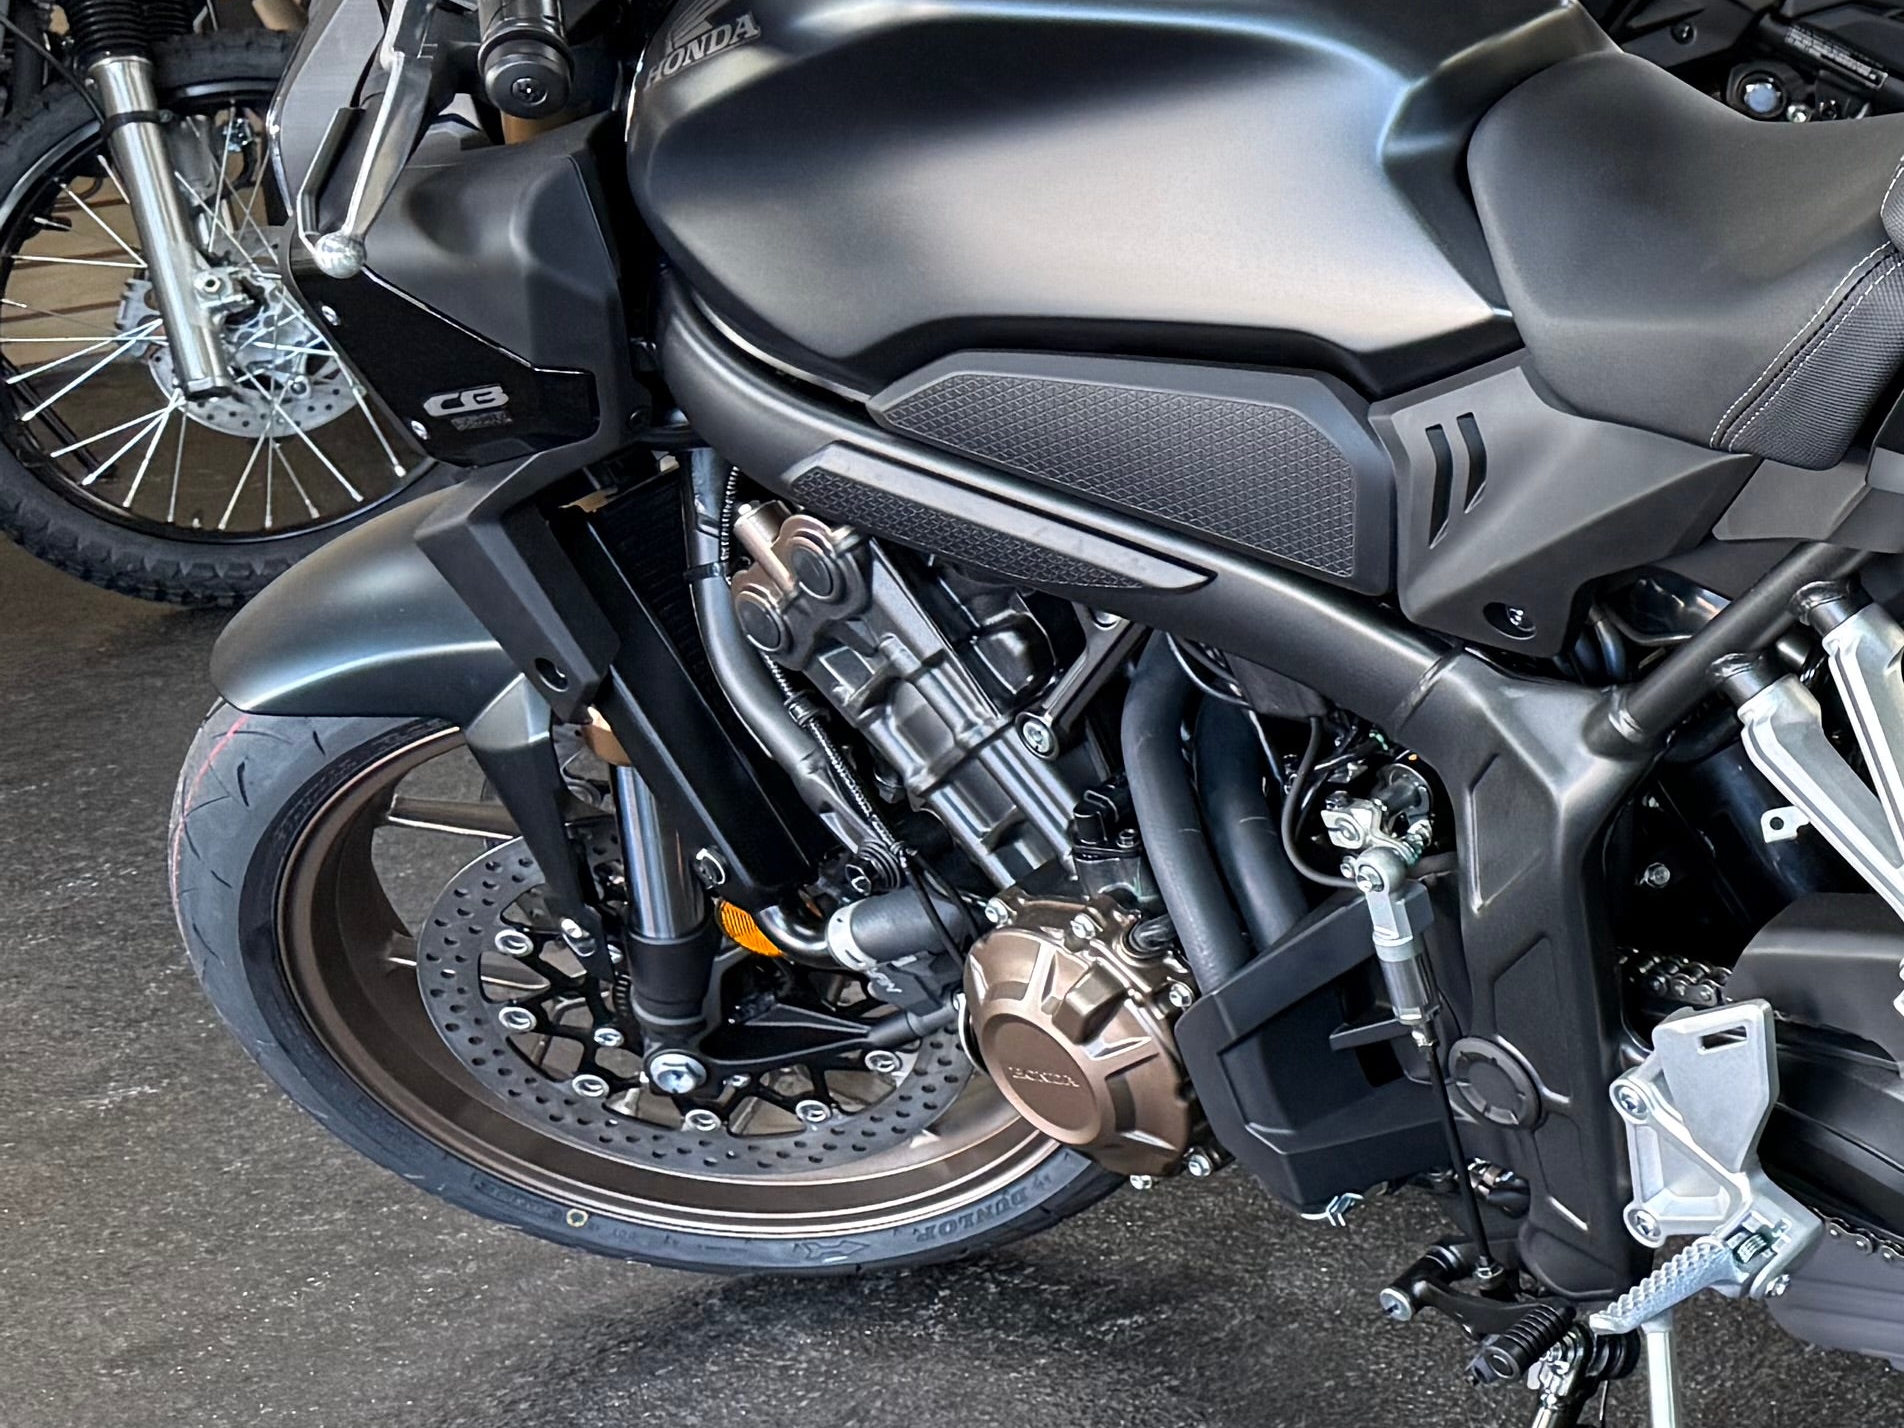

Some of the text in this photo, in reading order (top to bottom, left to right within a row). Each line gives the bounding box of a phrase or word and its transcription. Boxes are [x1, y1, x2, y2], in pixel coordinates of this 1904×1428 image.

[643, 13, 760, 88] HONDA
[423, 385, 509, 417] CB
[912, 1184, 1027, 1243] DUNLOP
